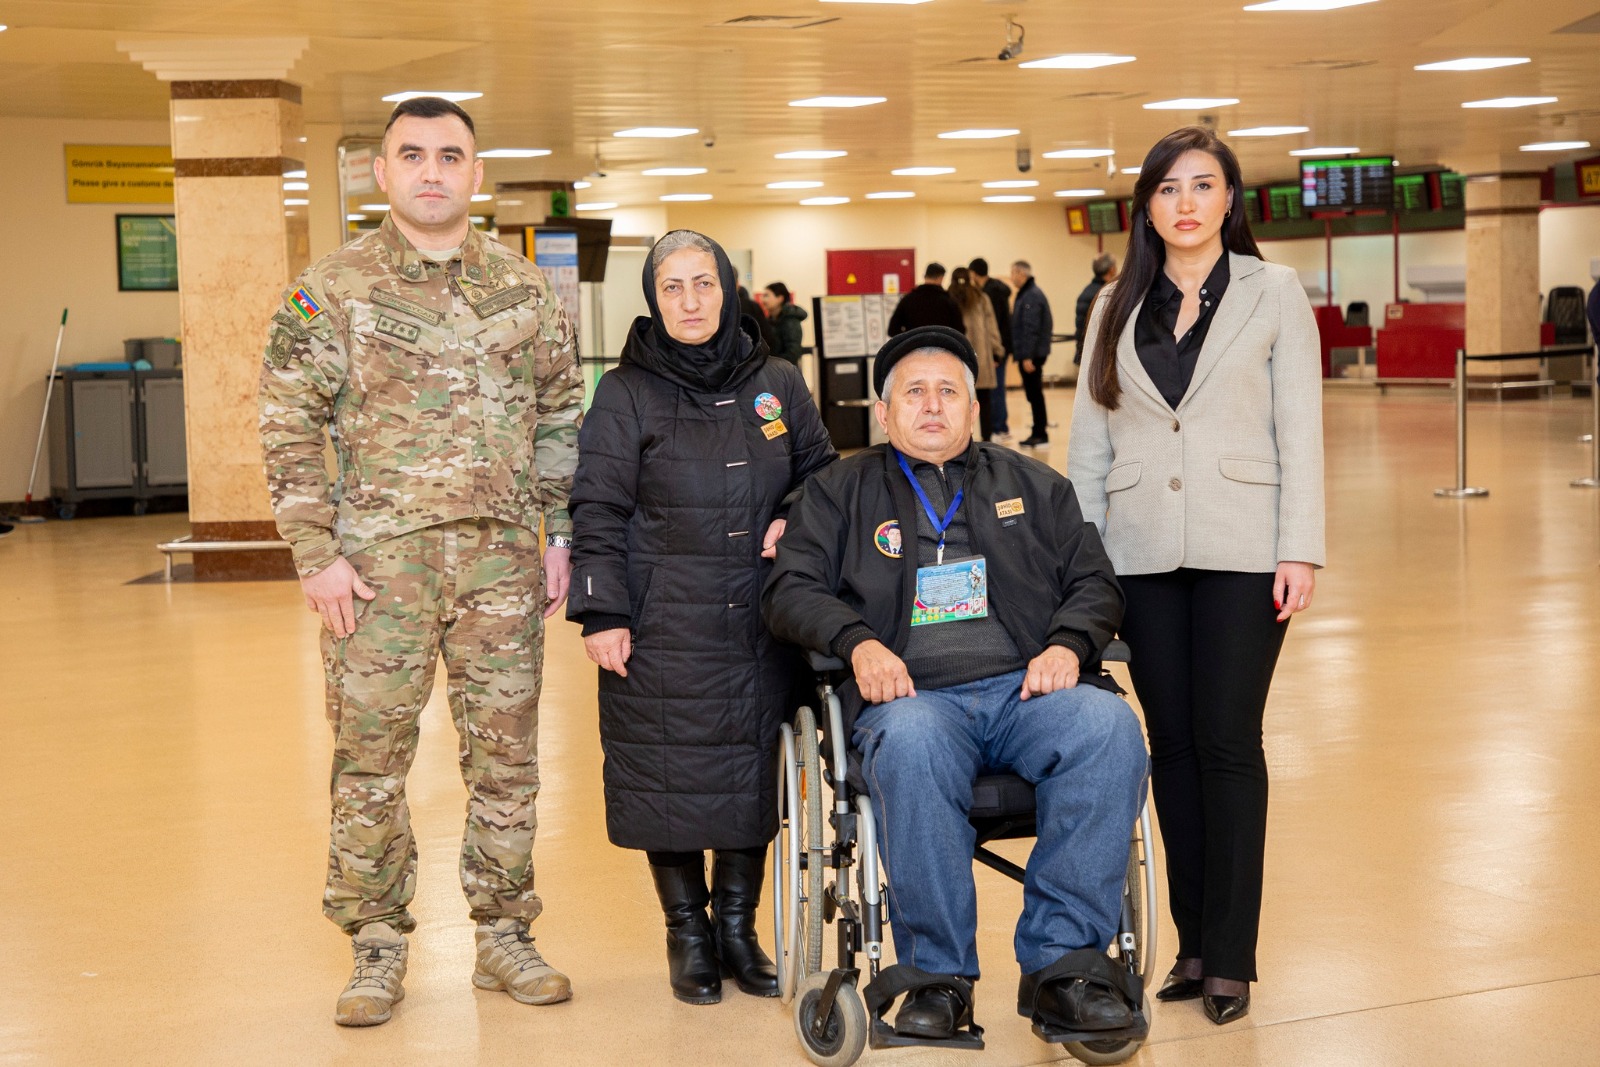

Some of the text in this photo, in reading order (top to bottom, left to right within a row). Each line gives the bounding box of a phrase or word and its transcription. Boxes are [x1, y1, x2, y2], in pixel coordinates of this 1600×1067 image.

[72, 159, 103, 168] Gömrük
[73, 179, 99, 187] Please
[102, 180, 118, 189] give
